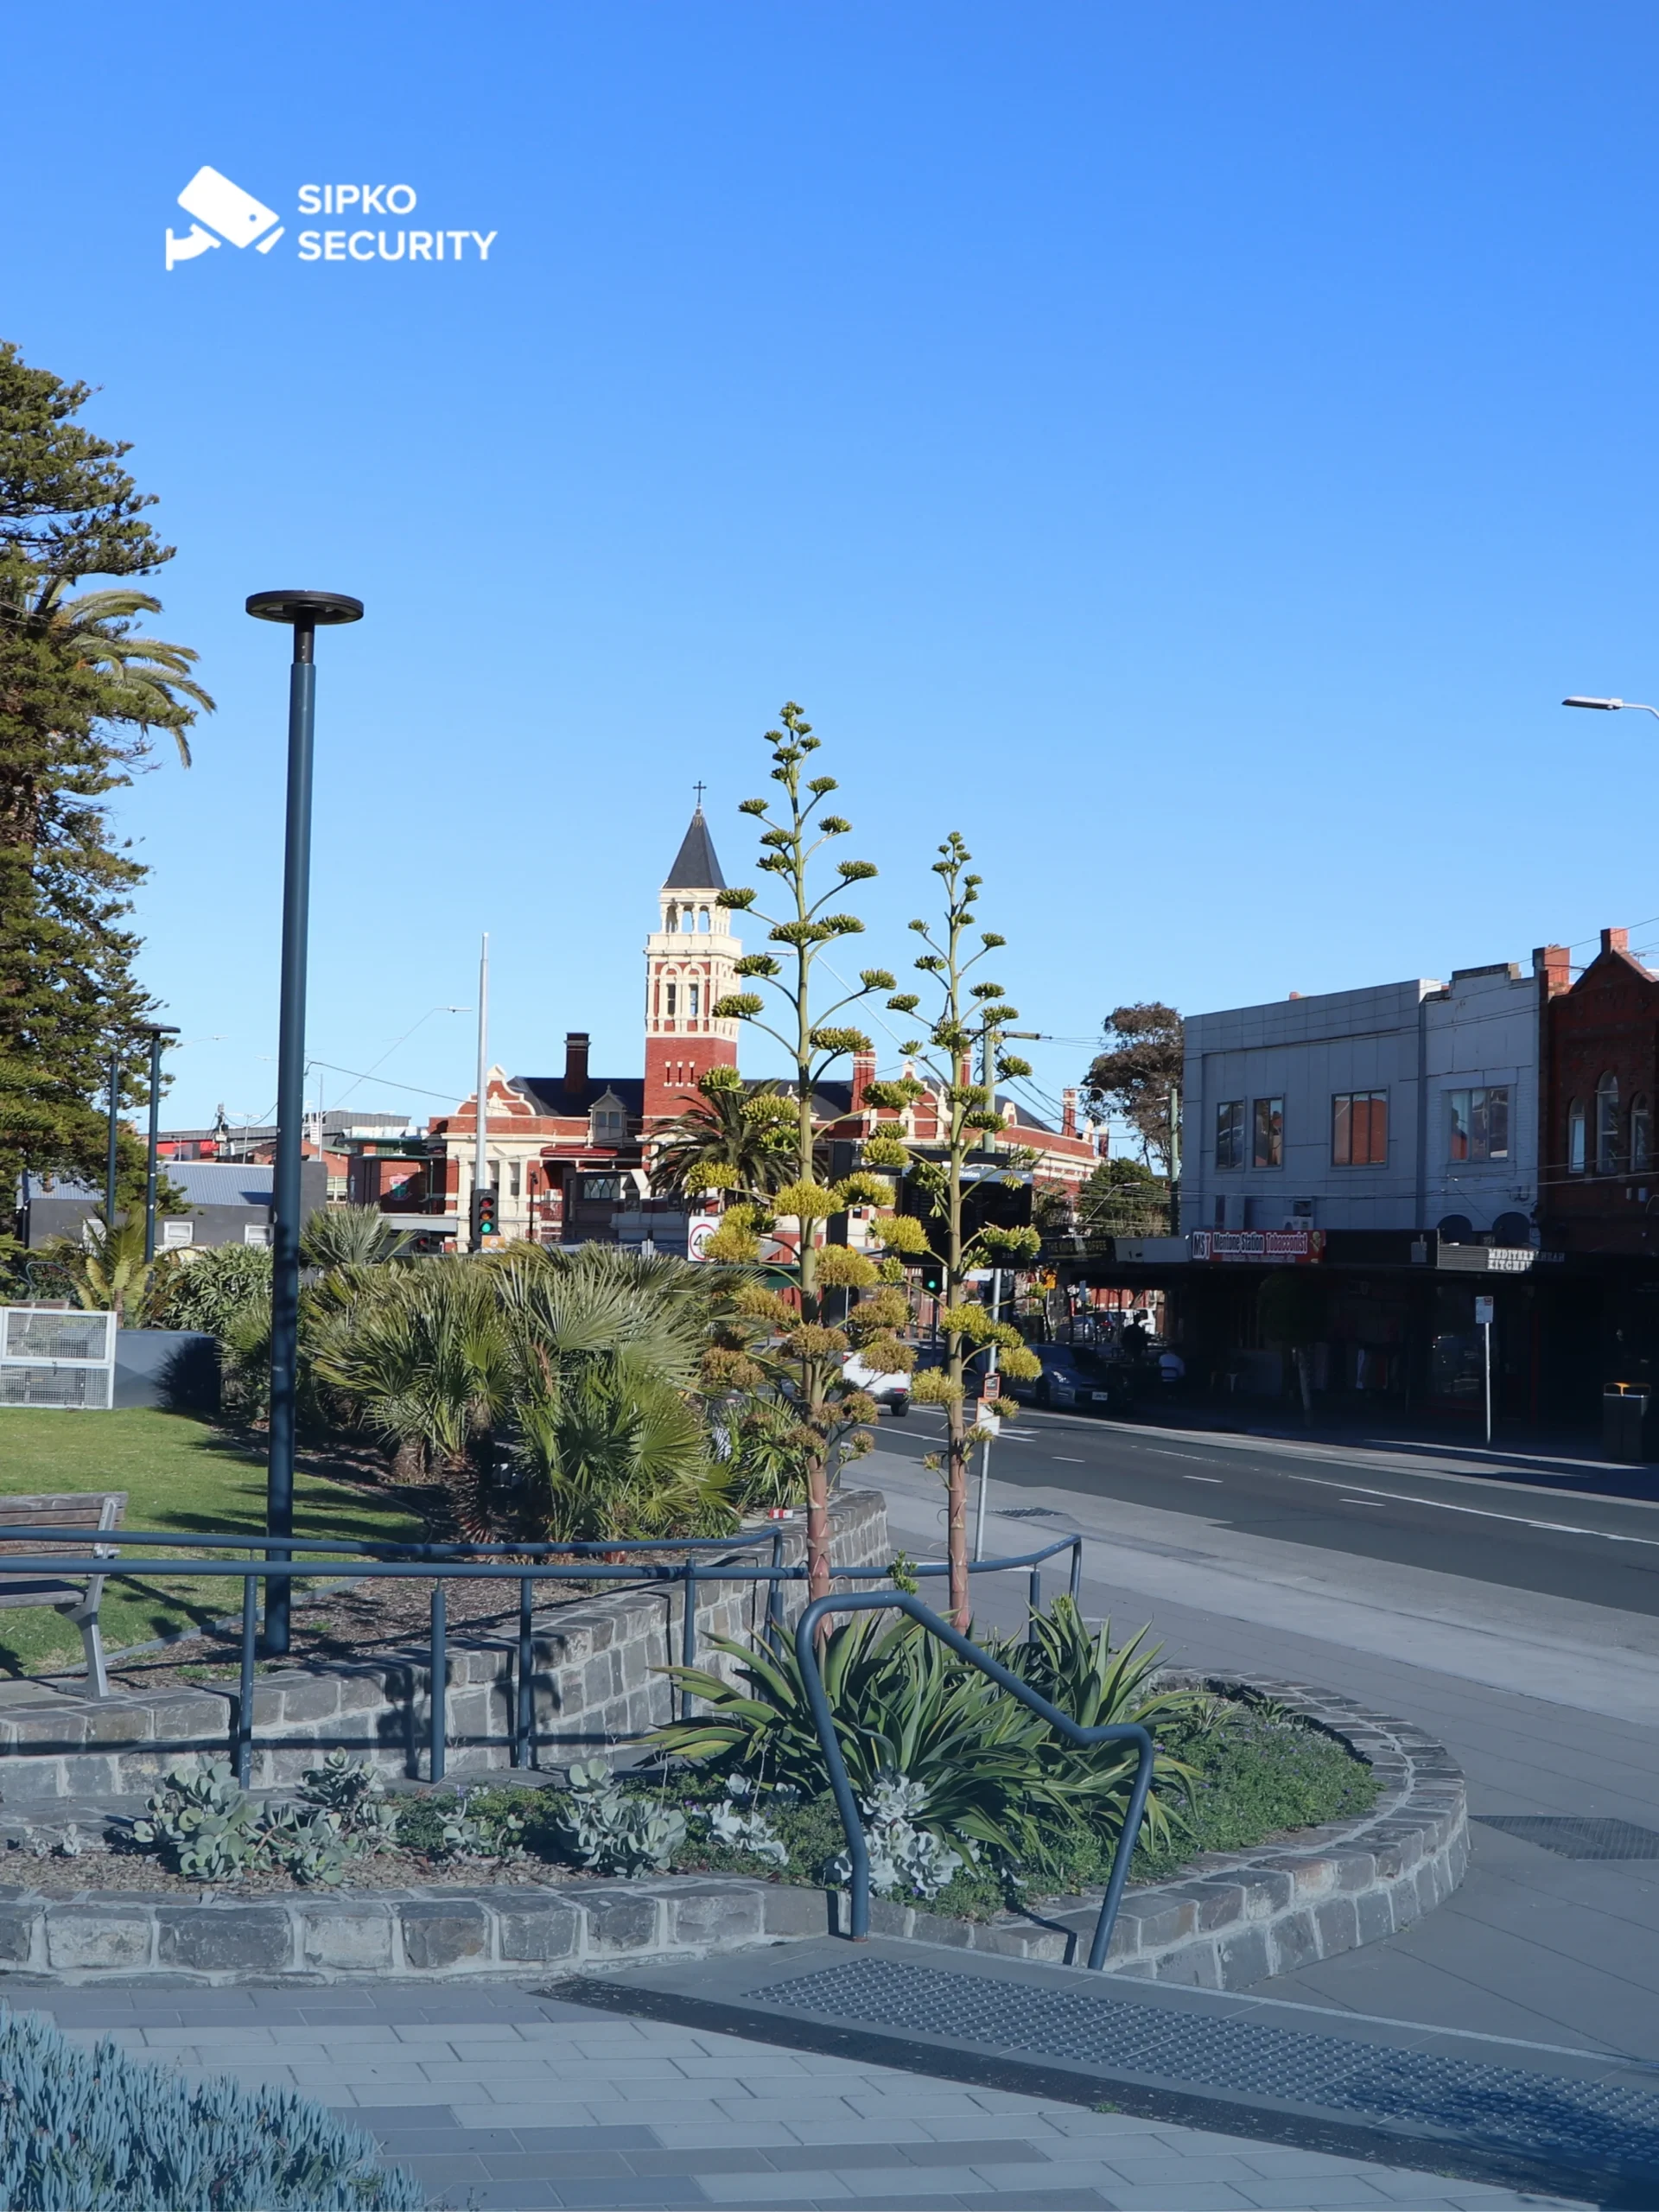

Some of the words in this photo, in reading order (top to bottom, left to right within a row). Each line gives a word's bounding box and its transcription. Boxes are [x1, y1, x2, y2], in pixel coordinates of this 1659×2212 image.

[1192, 1231, 1211, 1260] MST
[1212, 1232, 1240, 1253] Mentone
[1241, 1231, 1264, 1253] Station
[1266, 1231, 1307, 1254] Tobacconist
[1487, 1260, 1533, 1271] KITCHEN
